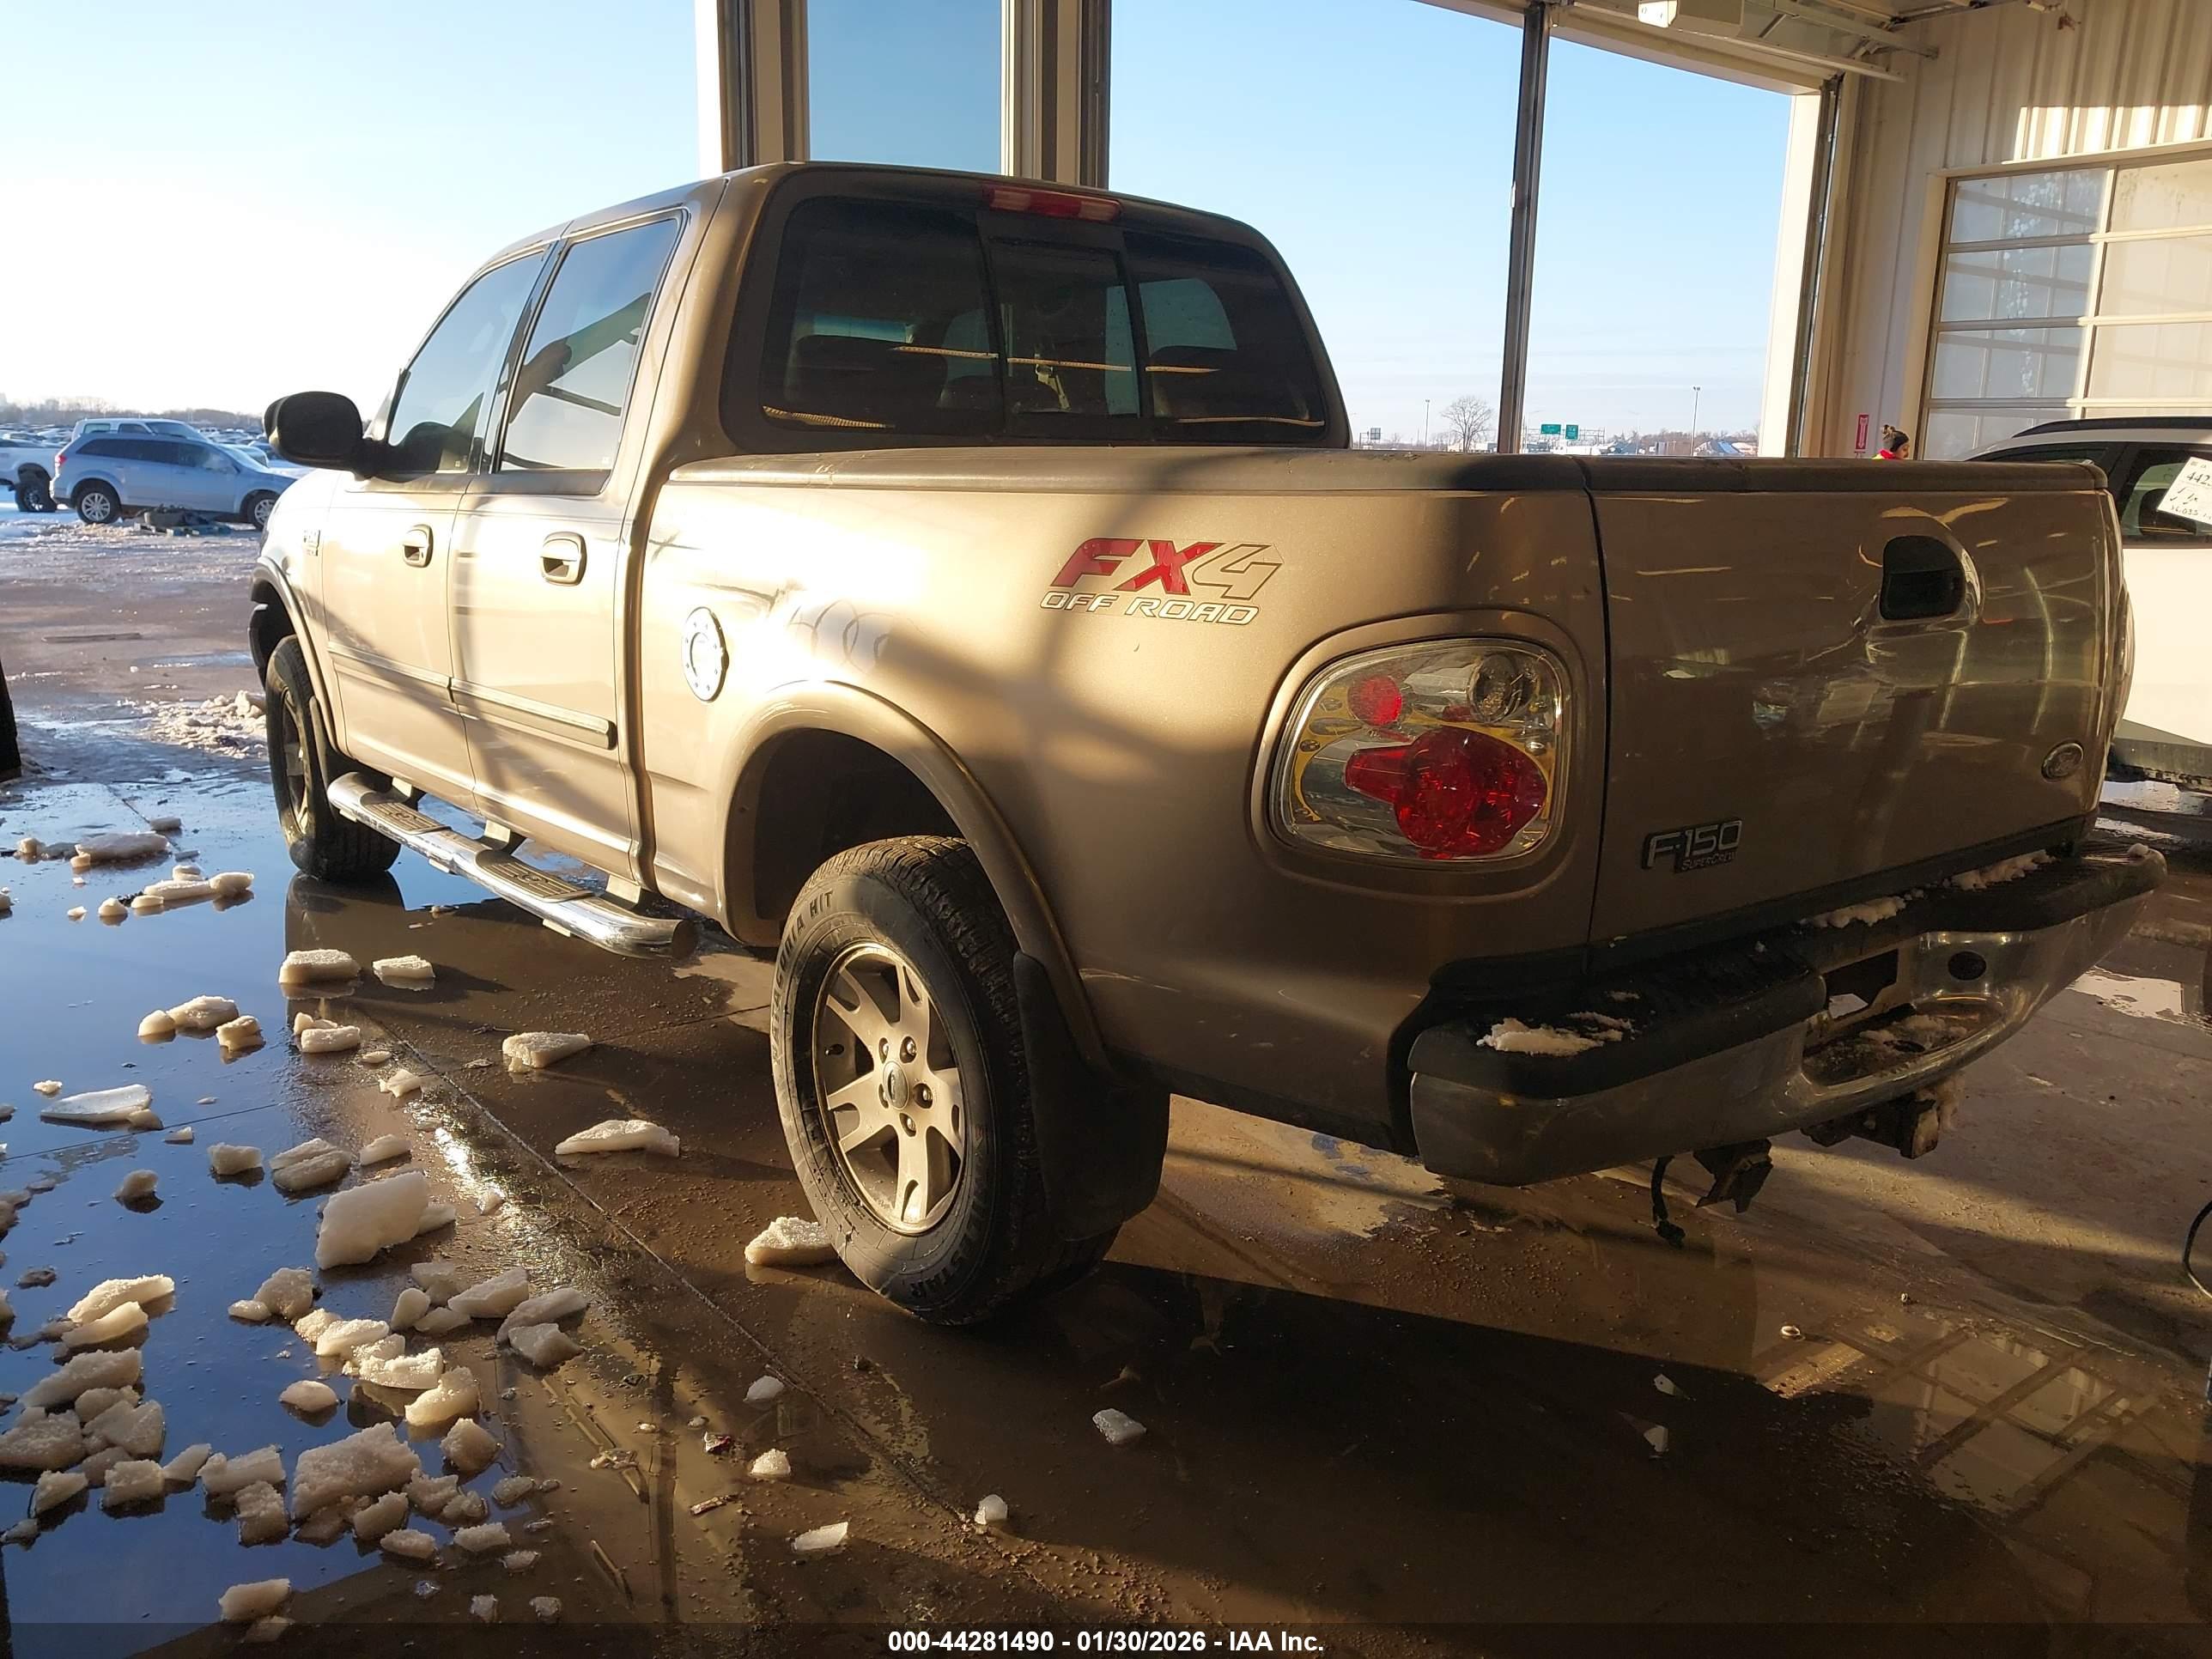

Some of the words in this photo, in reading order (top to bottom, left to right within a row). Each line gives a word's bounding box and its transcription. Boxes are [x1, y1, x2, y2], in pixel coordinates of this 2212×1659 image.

[1049, 538, 1283, 600] FX4
[1040, 591, 1119, 612] OFF
[1124, 597, 1260, 625] ROAD
